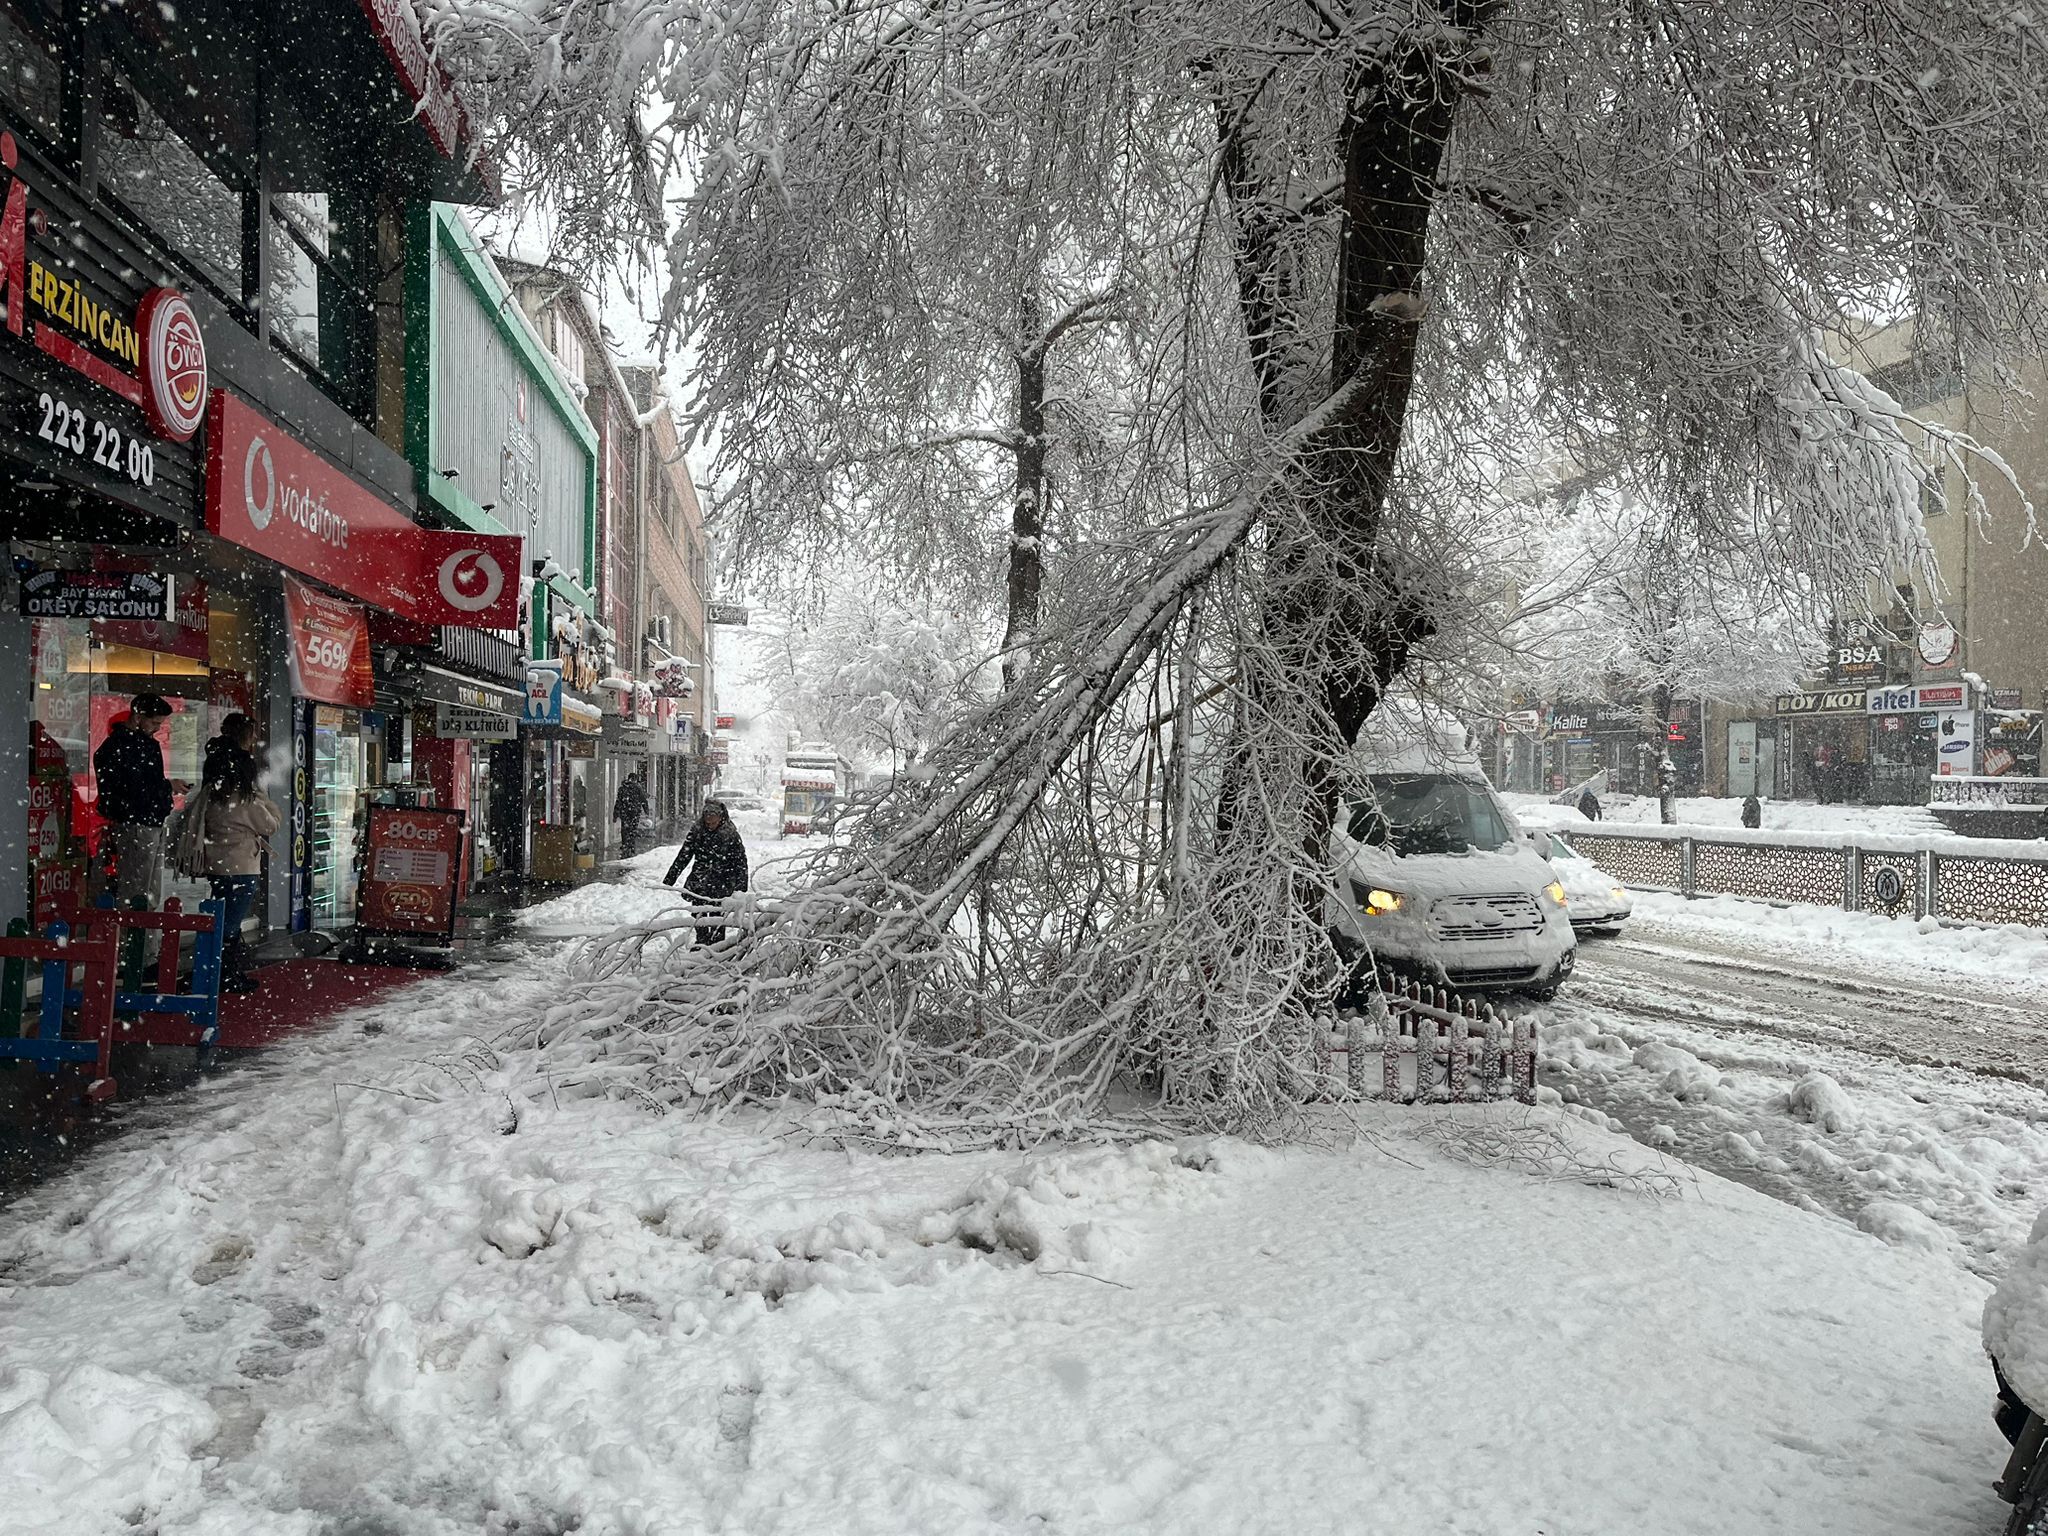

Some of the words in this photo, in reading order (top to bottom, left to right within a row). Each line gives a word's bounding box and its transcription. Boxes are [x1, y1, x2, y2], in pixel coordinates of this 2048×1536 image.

[31, 260, 139, 367] ERZİNCAN
[38, 393, 86, 454] 223
[93, 421, 121, 472] 22
[128, 438, 153, 486] 00
[280, 481, 349, 550] vodafone
[62, 588, 84, 599] BAY
[28, 599, 77, 614] OKEY
[85, 600, 160, 617] SALONU
[1838, 645, 1882, 665] BSA
[1777, 694, 1817, 711] BOY
[1825, 692, 1866, 708] KOT
[1871, 689, 1916, 711] altel
[1553, 714, 1588, 730] Kalite
[387, 820, 438, 841] 80GB
